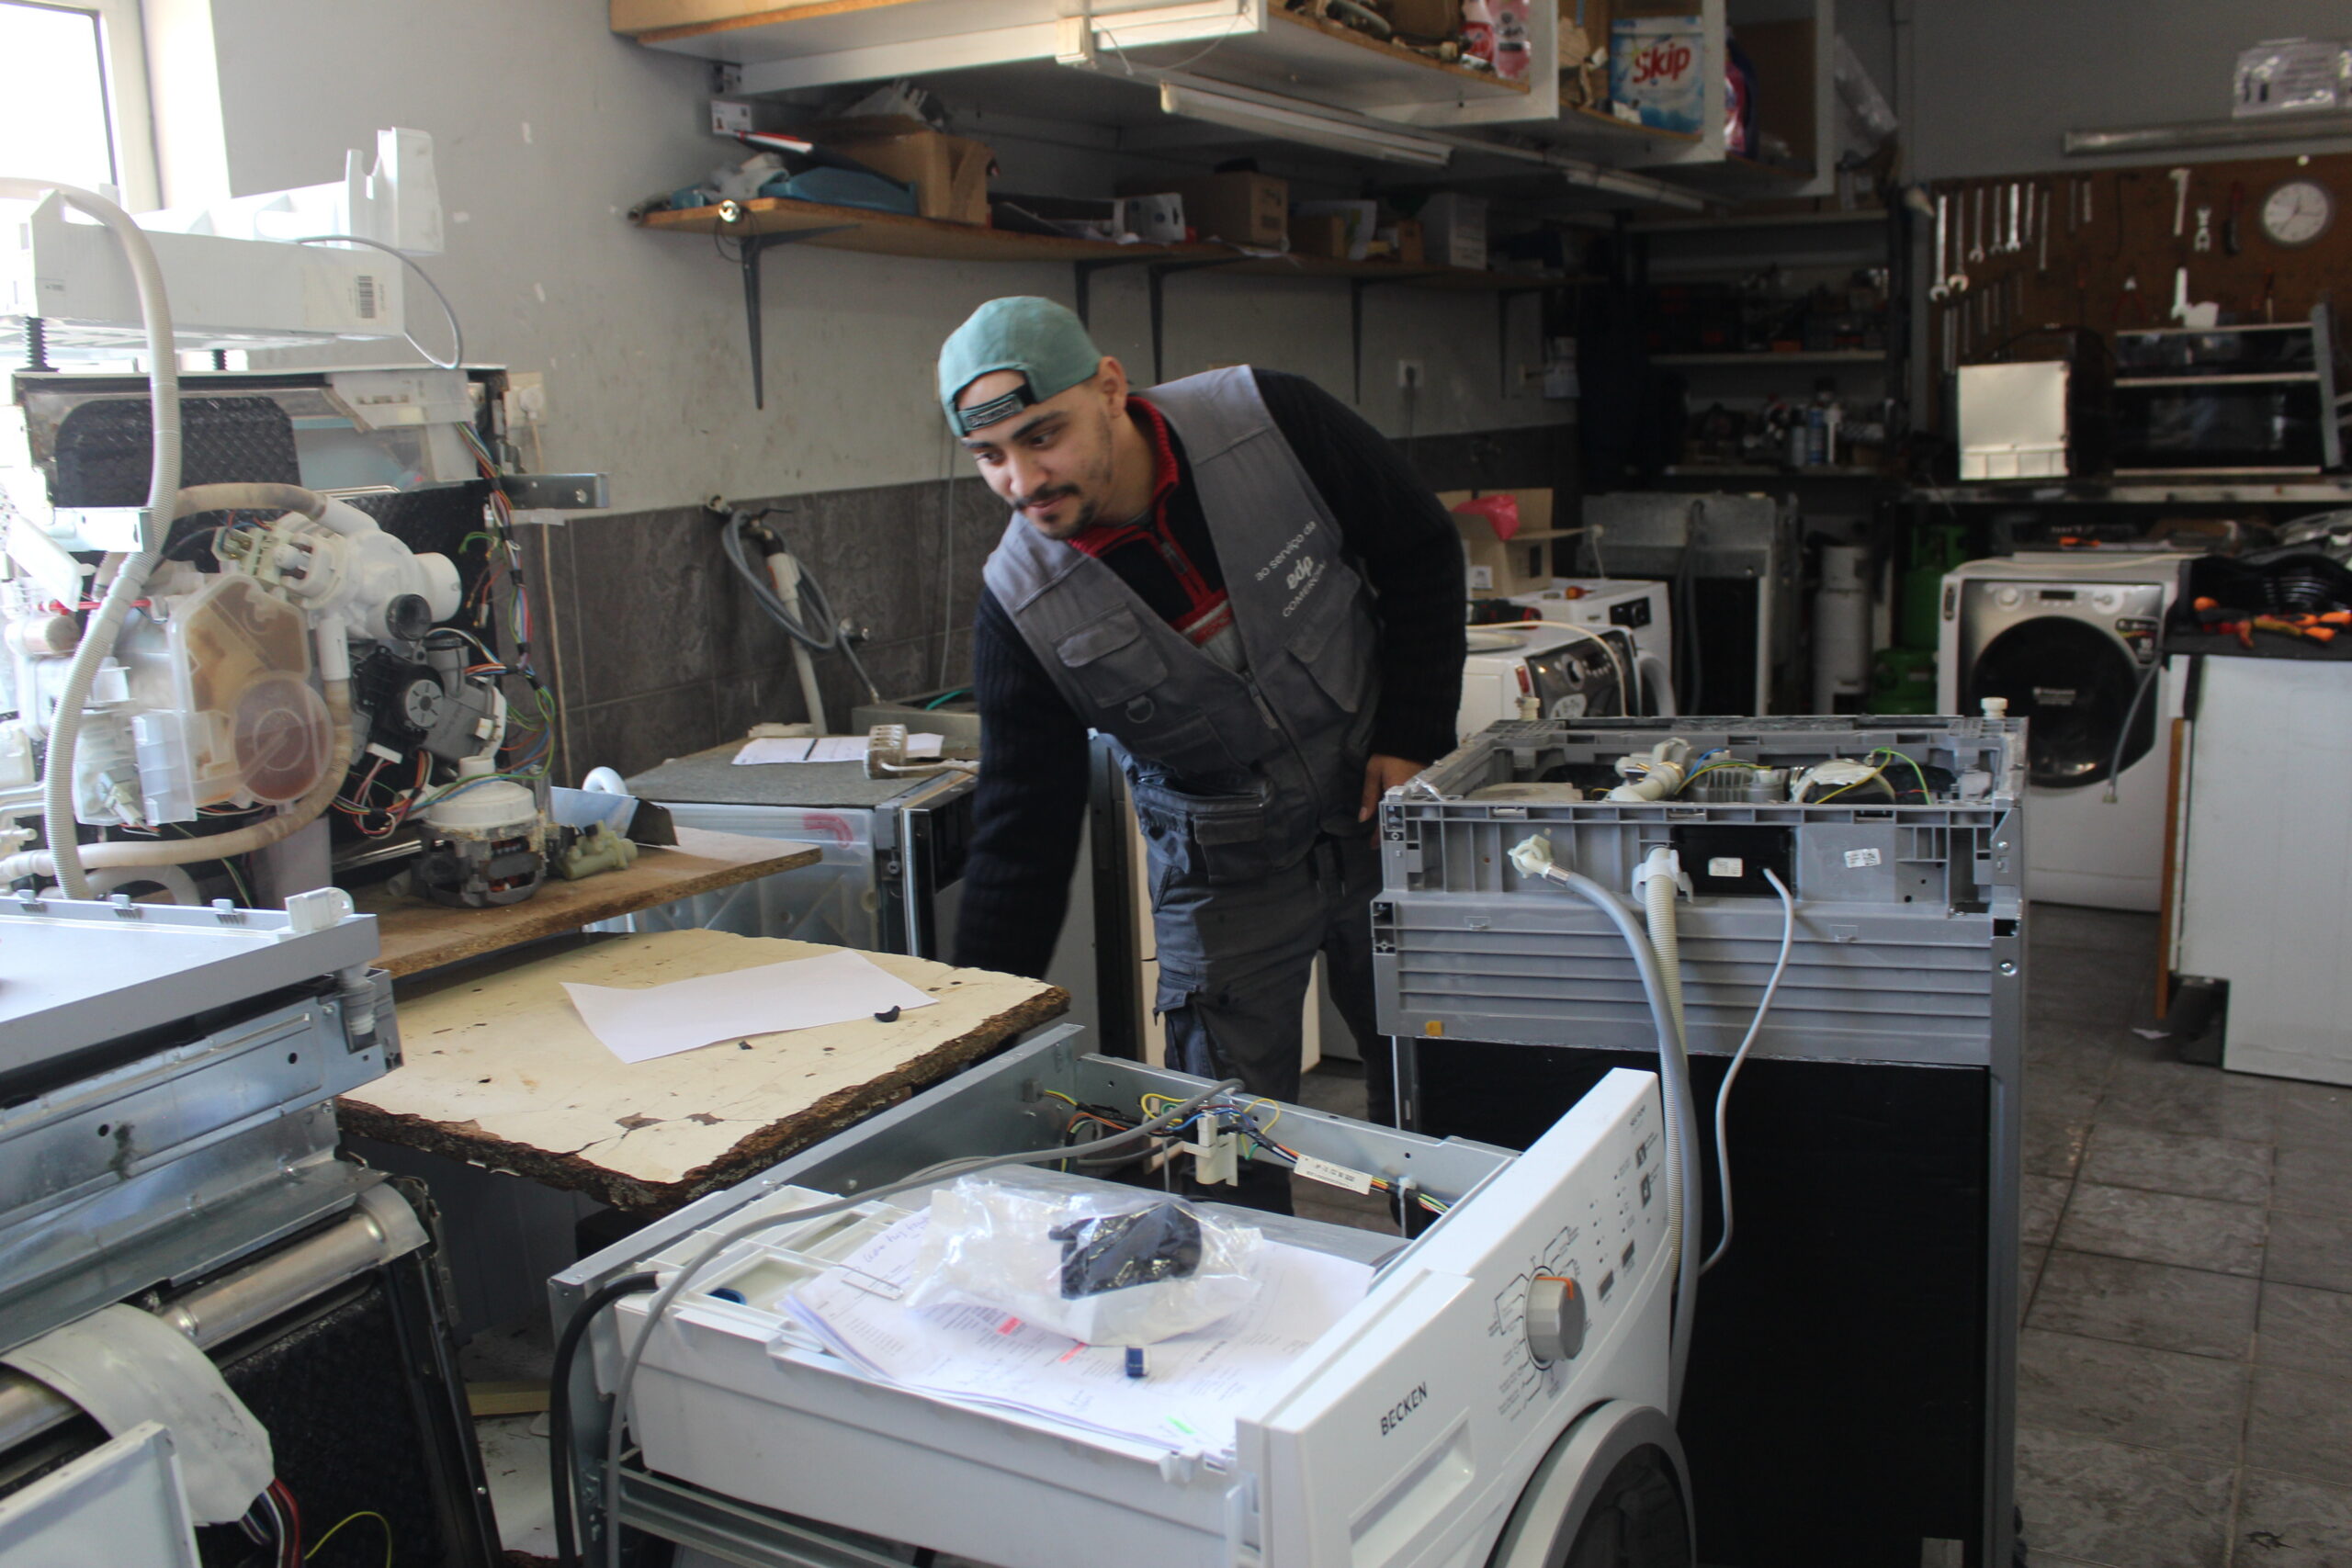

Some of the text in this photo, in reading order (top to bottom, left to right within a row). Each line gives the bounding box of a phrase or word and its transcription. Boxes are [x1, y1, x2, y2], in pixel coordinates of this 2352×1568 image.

[1255, 521, 1317, 581] ao serviço da
[1286, 556, 1314, 590] edp
[1380, 1381, 1428, 1437] BECKEN
